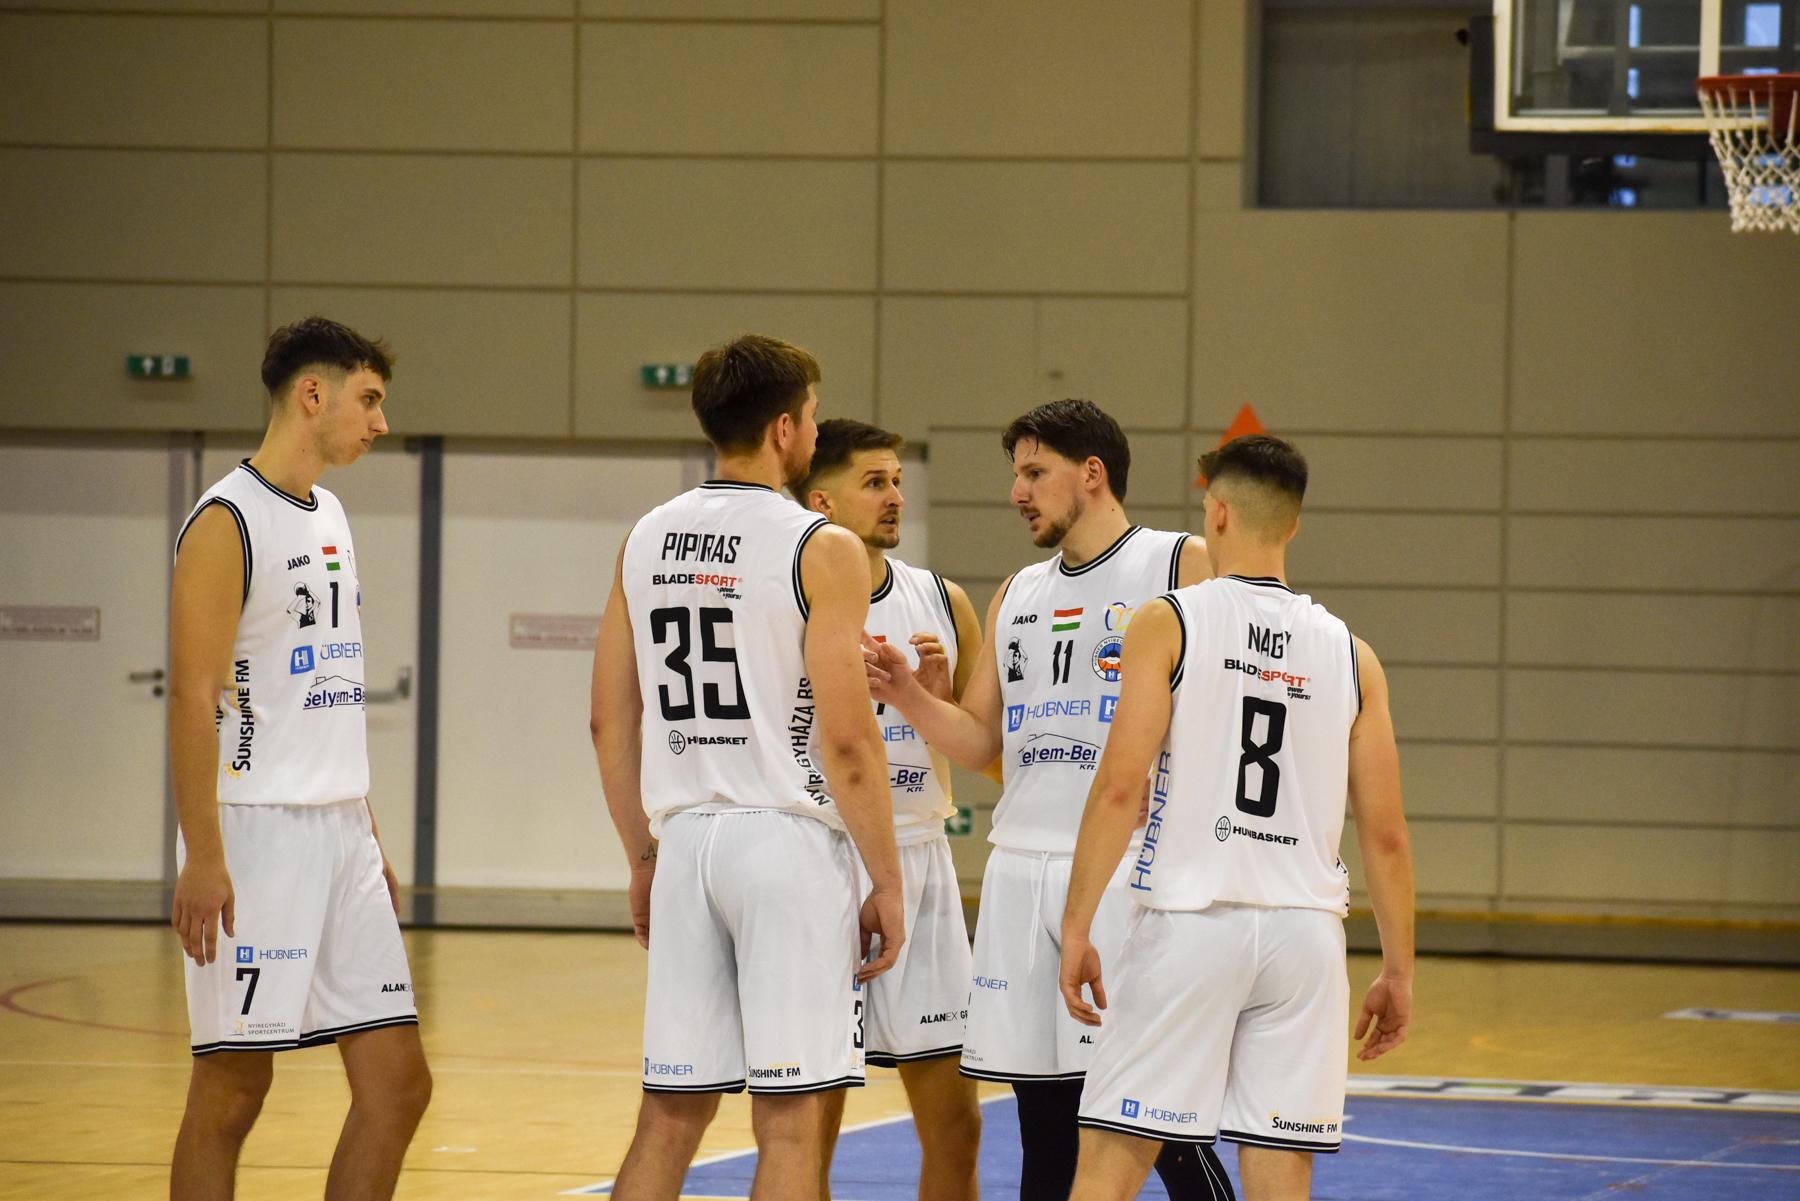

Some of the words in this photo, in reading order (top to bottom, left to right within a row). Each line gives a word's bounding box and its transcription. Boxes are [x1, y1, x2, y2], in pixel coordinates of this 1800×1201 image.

[661, 532, 741, 564] PIPIRAS
[288, 555, 311, 570] JAKO
[653, 573, 737, 588] BLADESPORT
[329, 581, 339, 628] 1
[1012, 614, 1038, 625] JAKO
[320, 642, 363, 660] ÜBNER
[1248, 622, 1292, 659] NAGY
[235, 659, 250, 683] FM
[650, 606, 751, 721] 35
[1052, 639, 1074, 686] 11
[232, 687, 255, 771] SUNSHINE
[687, 735, 748, 745] HBASKET
[788, 705, 830, 806] NYÍRGYHÁZA
[1235, 695, 1287, 818] 8
[906, 785, 925, 793] Kft.
[1130, 750, 1171, 892] HÜBNER
[1233, 825, 1299, 846] HUNBASKET
[260, 948, 308, 960] HÜBNER
[236, 967, 261, 1016] 7
[853, 1000, 864, 1049] 3
[919, 1011, 958, 1025] ALANEX
[787, 1066, 801, 1077] FM
[1144, 1106, 1198, 1123] HÜBNER
[1272, 1116, 1325, 1133] SUNSHINE
[1327, 1123, 1338, 1134] FM
